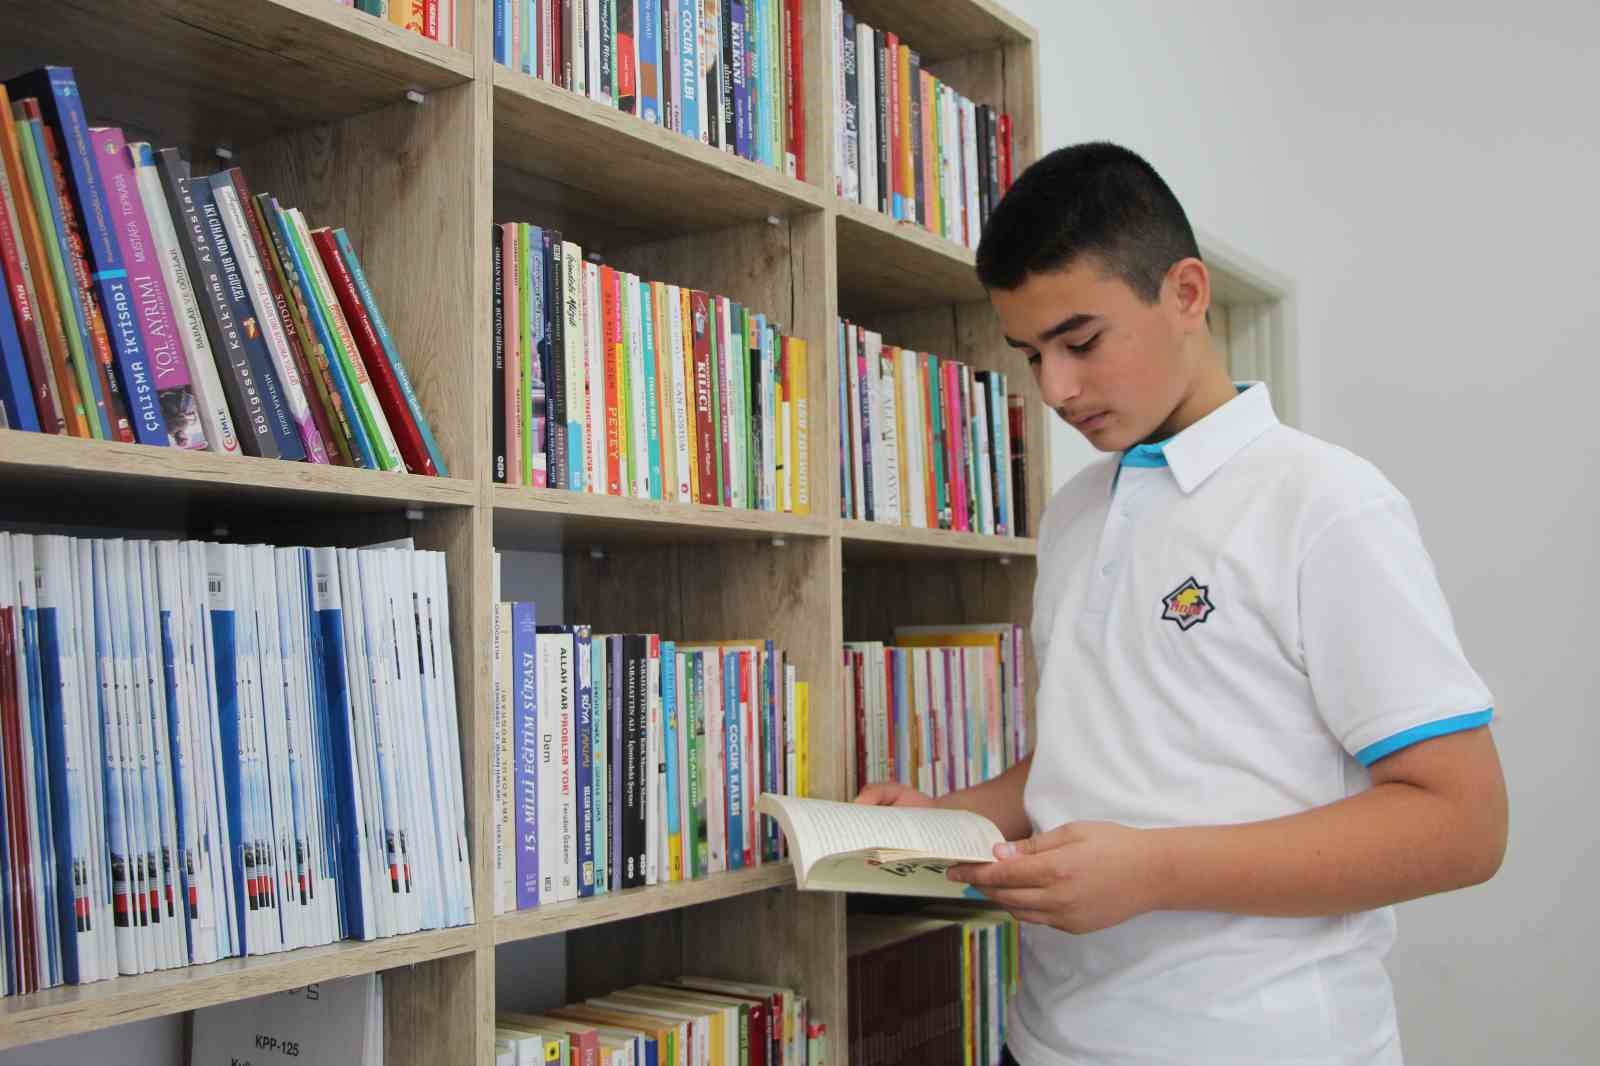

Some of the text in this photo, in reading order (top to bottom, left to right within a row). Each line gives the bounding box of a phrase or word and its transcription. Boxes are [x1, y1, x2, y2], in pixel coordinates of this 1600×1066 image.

[206, 216, 229, 258] CİHANDA
[226, 272, 245, 303] GÜZEL
[14, 283, 33, 322] NUTUK
[133, 273, 166, 339] AYRIMI
[175, 174, 270, 435] Bölgesel Kalkınma Ajansları
[107, 281, 164, 432] ÇALIŞMA İKTİSADI
[150, 342, 176, 378] YOL
[607, 406, 619, 458] PETEY
[558, 647, 568, 683] ALLAH
[558, 686, 567, 709] VAR
[580, 694, 590, 724] RÜYA
[558, 712, 569, 763] PROBLEM
[628, 714, 636, 731] ALİ
[521, 716, 536, 775] EĞİTİM
[542, 733, 553, 763] Dem
[522, 780, 536, 824] MİLLİ
[524, 830, 536, 852] 15.
[255, 1034, 299, 1057] KPP-125
